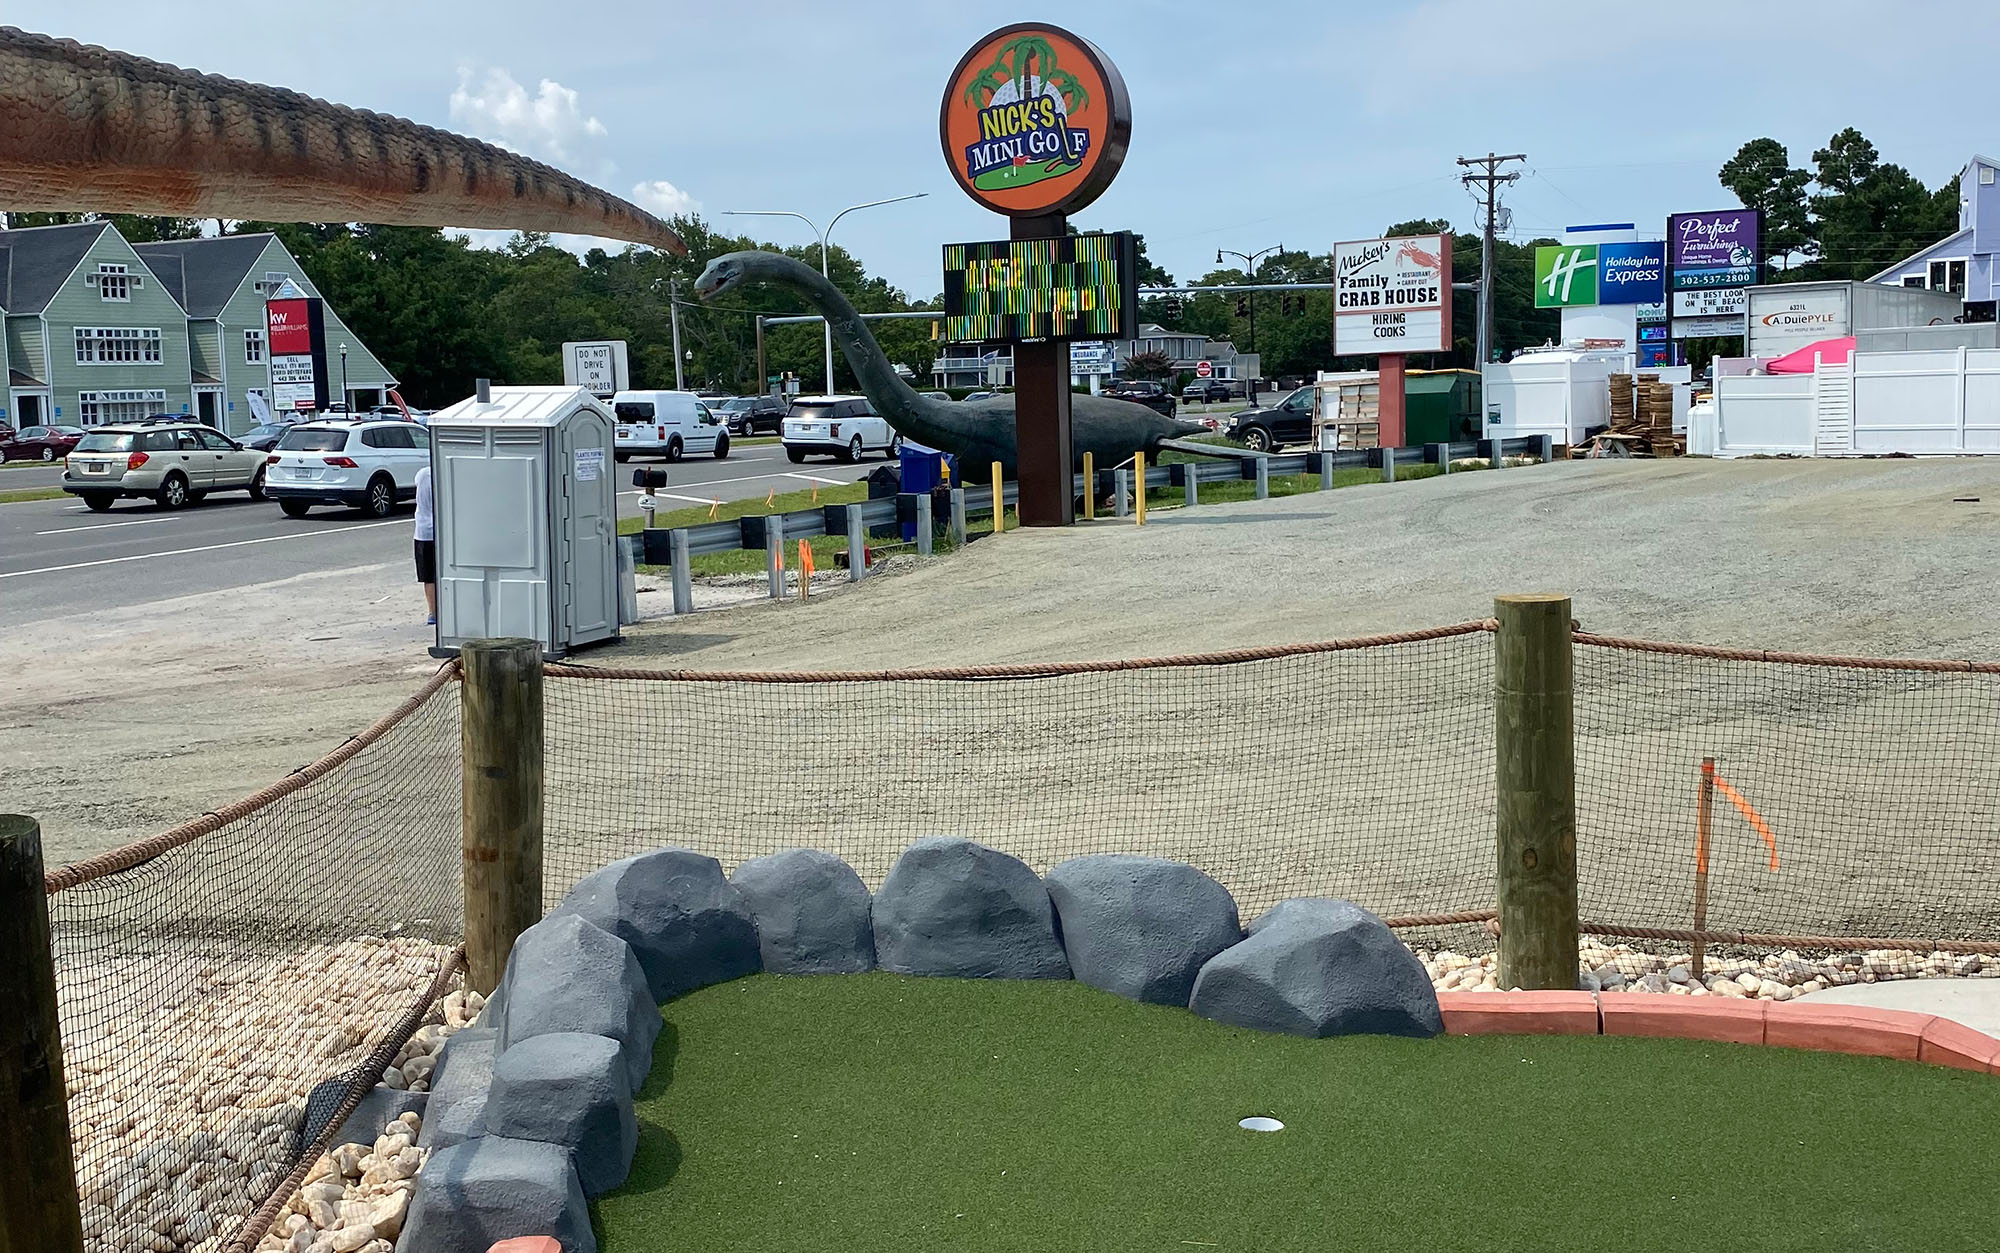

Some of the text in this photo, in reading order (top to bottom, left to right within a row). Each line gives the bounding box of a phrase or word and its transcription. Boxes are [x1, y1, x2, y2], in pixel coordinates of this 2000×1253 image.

[982, 98, 1055, 140] NICK'S
[972, 118, 1086, 171] MINI GOLF
[1680, 218, 1741, 240] Perfect
[1682, 238, 1739, 255] Furnishings
[1337, 241, 1390, 279] Mickey's
[1605, 256, 1660, 268] Holiday Inn
[1340, 274, 1389, 290] Family
[1605, 268, 1659, 285] Express
[1681, 273, 1750, 285] 302-537-2800
[1340, 287, 1438, 307] CRAB HOUSE
[1687, 290, 1744, 300] THE BEST LOOK
[269, 309, 288, 325] kw
[1700, 306, 1708, 314] IS
[1372, 313, 1406, 325] HIRING
[1373, 326, 1406, 338] COOKS
[579, 349, 607, 358] DO NOT
[584, 361, 604, 369] DRIVE
